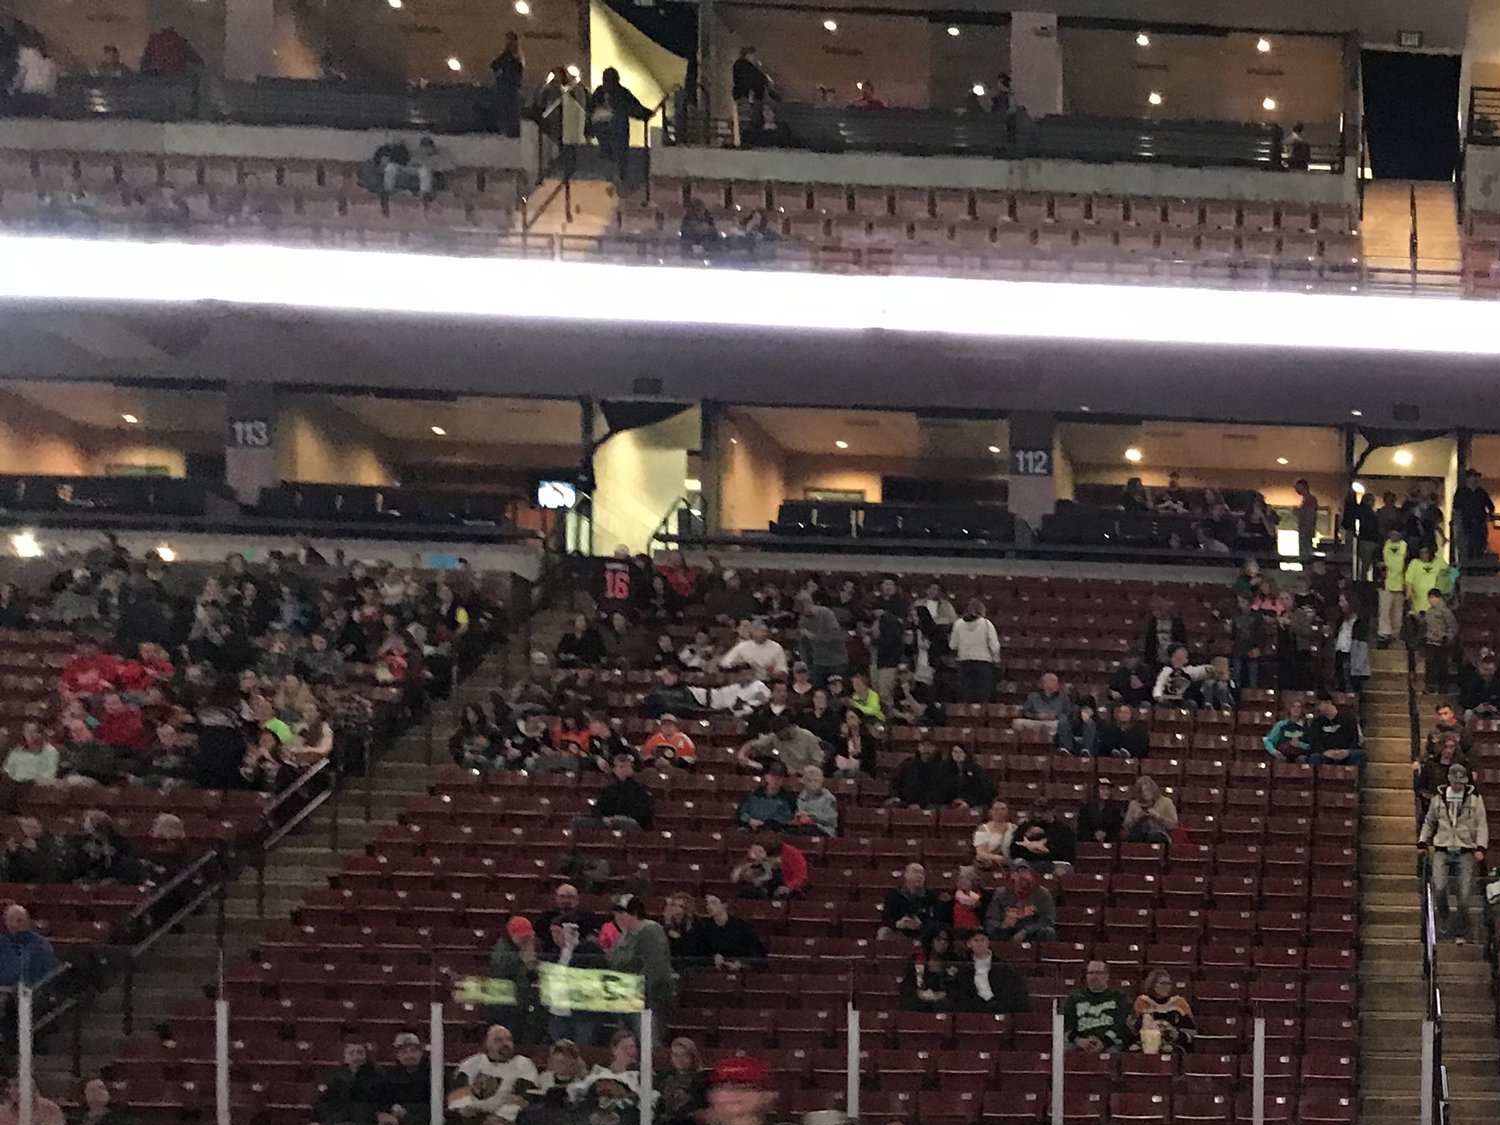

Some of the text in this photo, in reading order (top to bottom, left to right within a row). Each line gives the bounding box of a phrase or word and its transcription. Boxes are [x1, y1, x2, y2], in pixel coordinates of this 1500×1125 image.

[232, 420, 269, 446] 113
[1015, 450, 1048, 473] 112
[603, 570, 630, 599] 16
